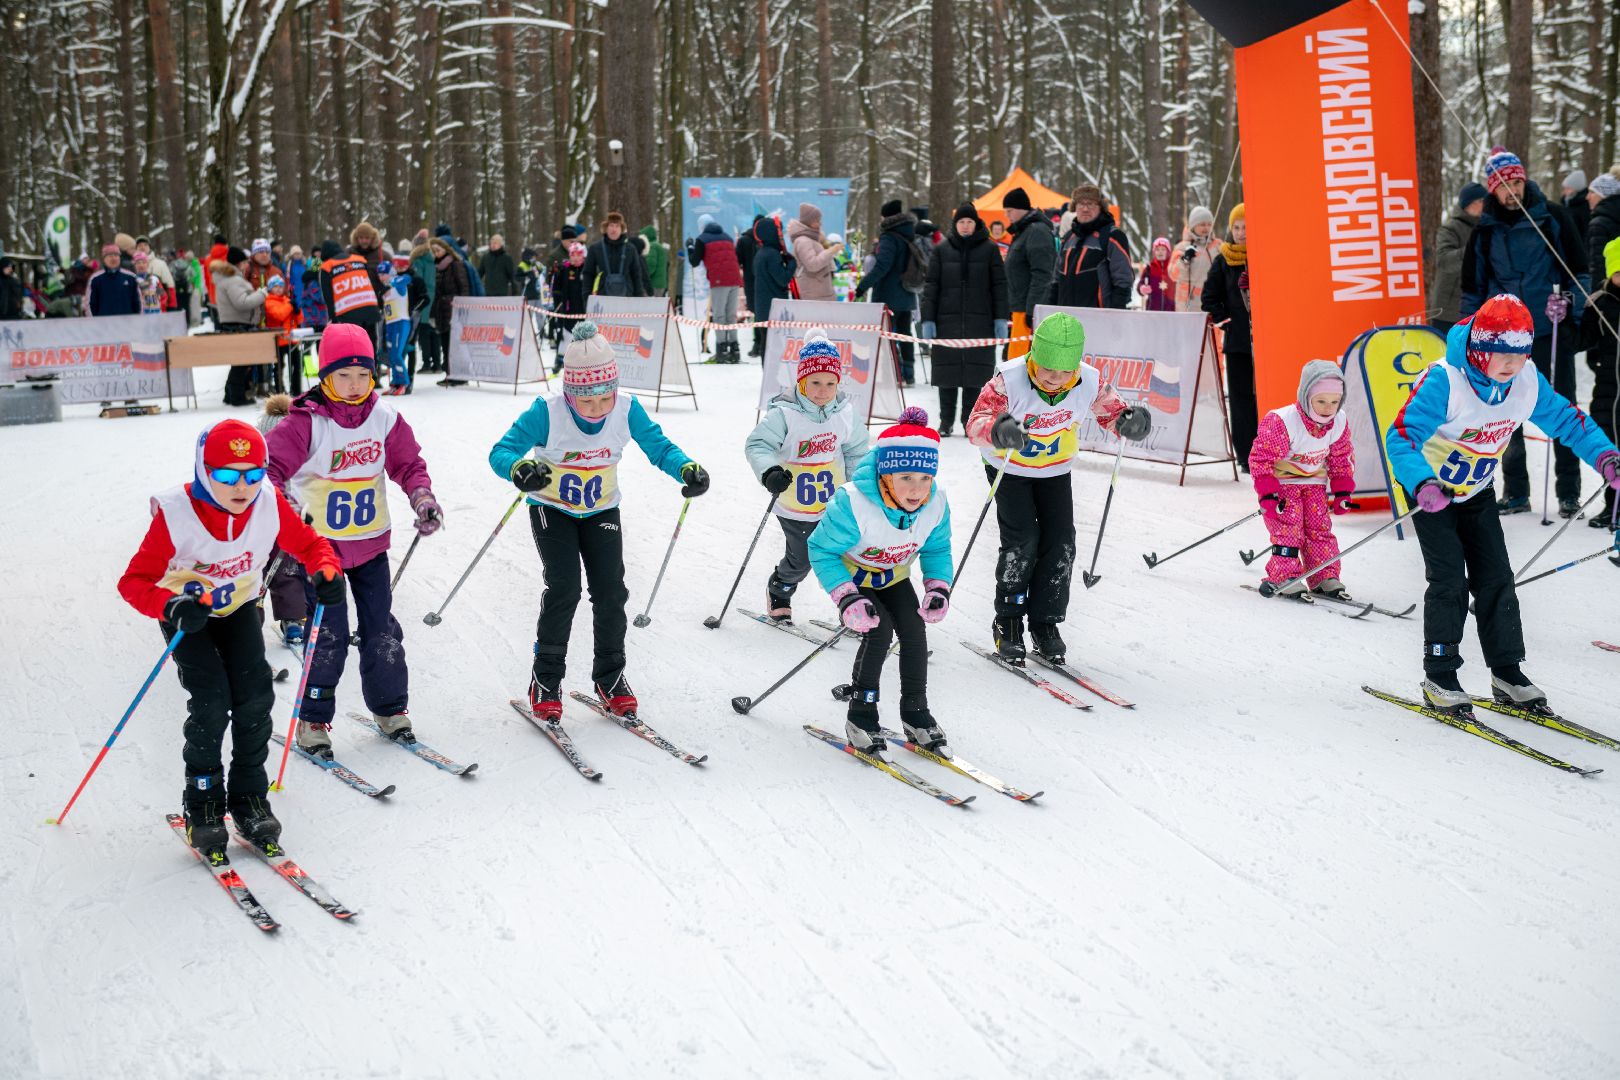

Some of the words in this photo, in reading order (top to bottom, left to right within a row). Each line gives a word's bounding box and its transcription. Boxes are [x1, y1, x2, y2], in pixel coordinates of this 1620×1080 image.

[1305, 27, 1383, 302] МОСКОВСКИЙ
[1381, 172, 1420, 297] СПОРТ
[11, 343, 133, 369] ВОЛКУША
[559, 473, 603, 509] 60
[796, 470, 836, 506] 63
[326, 488, 377, 530] 68
